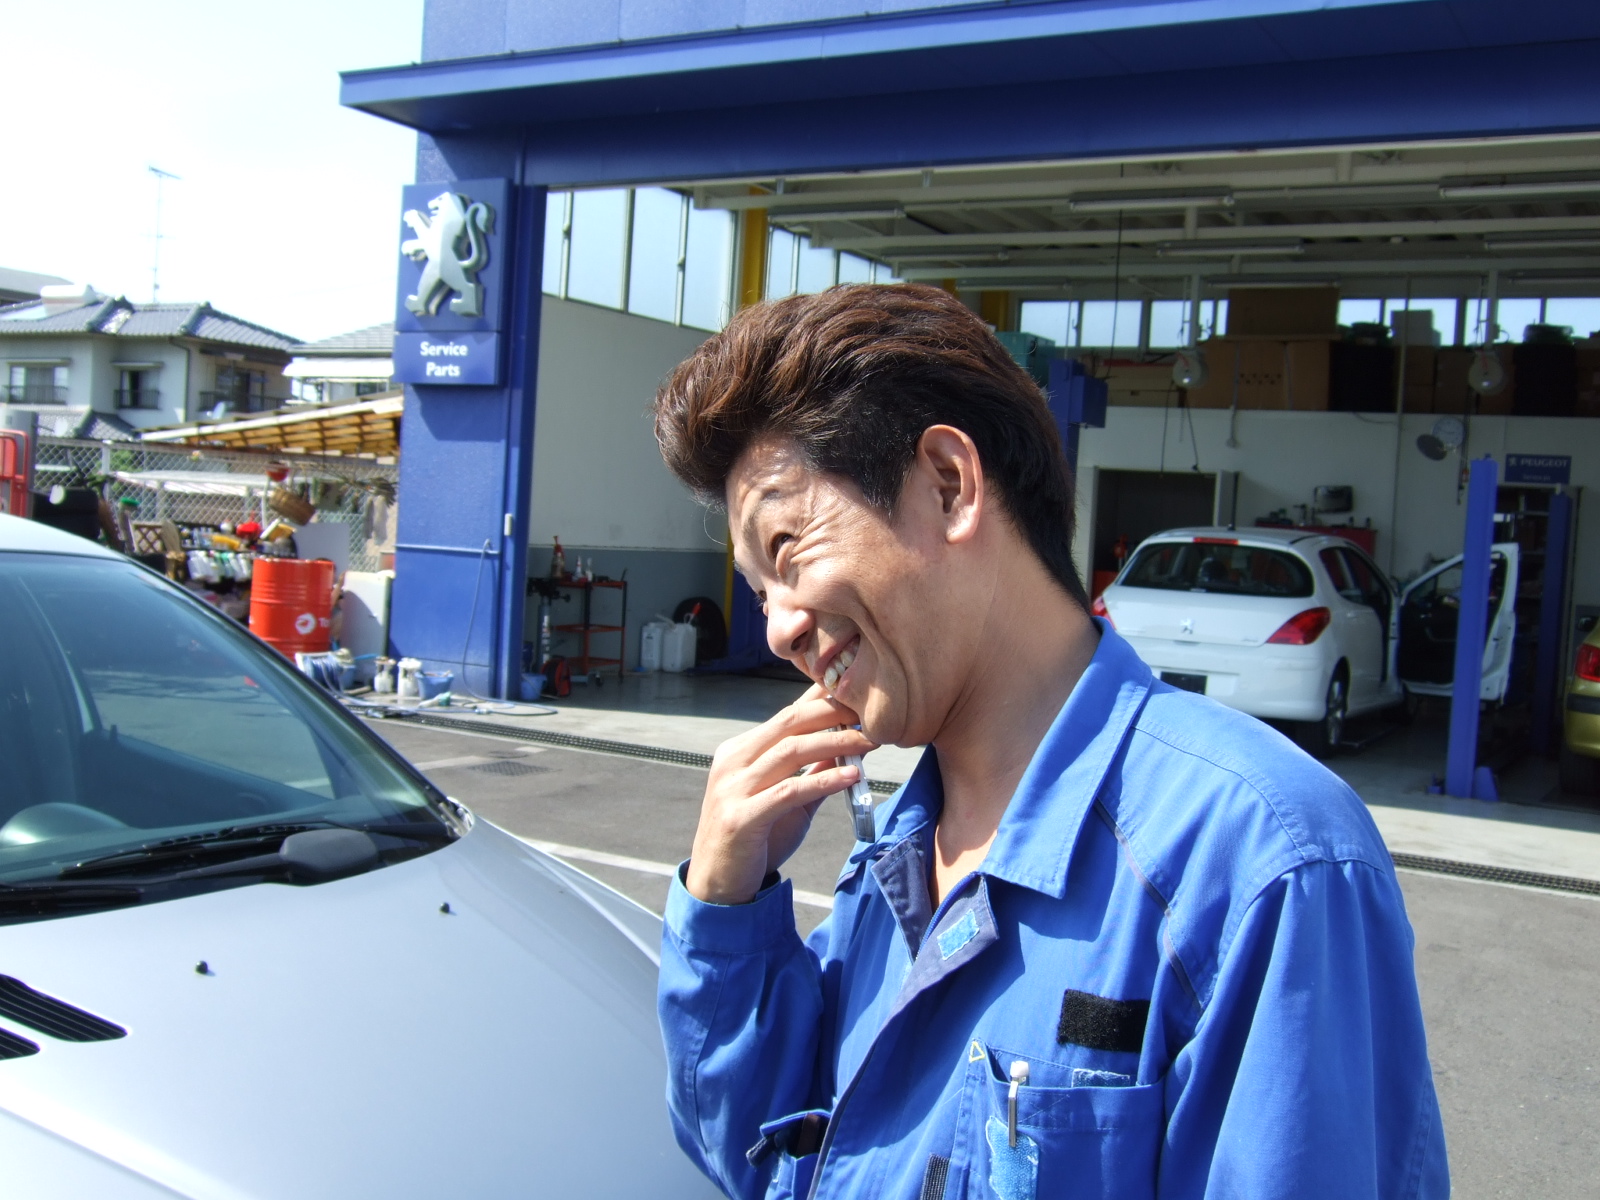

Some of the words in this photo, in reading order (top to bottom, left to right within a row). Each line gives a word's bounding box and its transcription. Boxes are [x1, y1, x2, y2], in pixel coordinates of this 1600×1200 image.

[420, 341, 468, 356] Service
[426, 361, 461, 377] Parts
[1521, 457, 1568, 468] PEUGEOT
